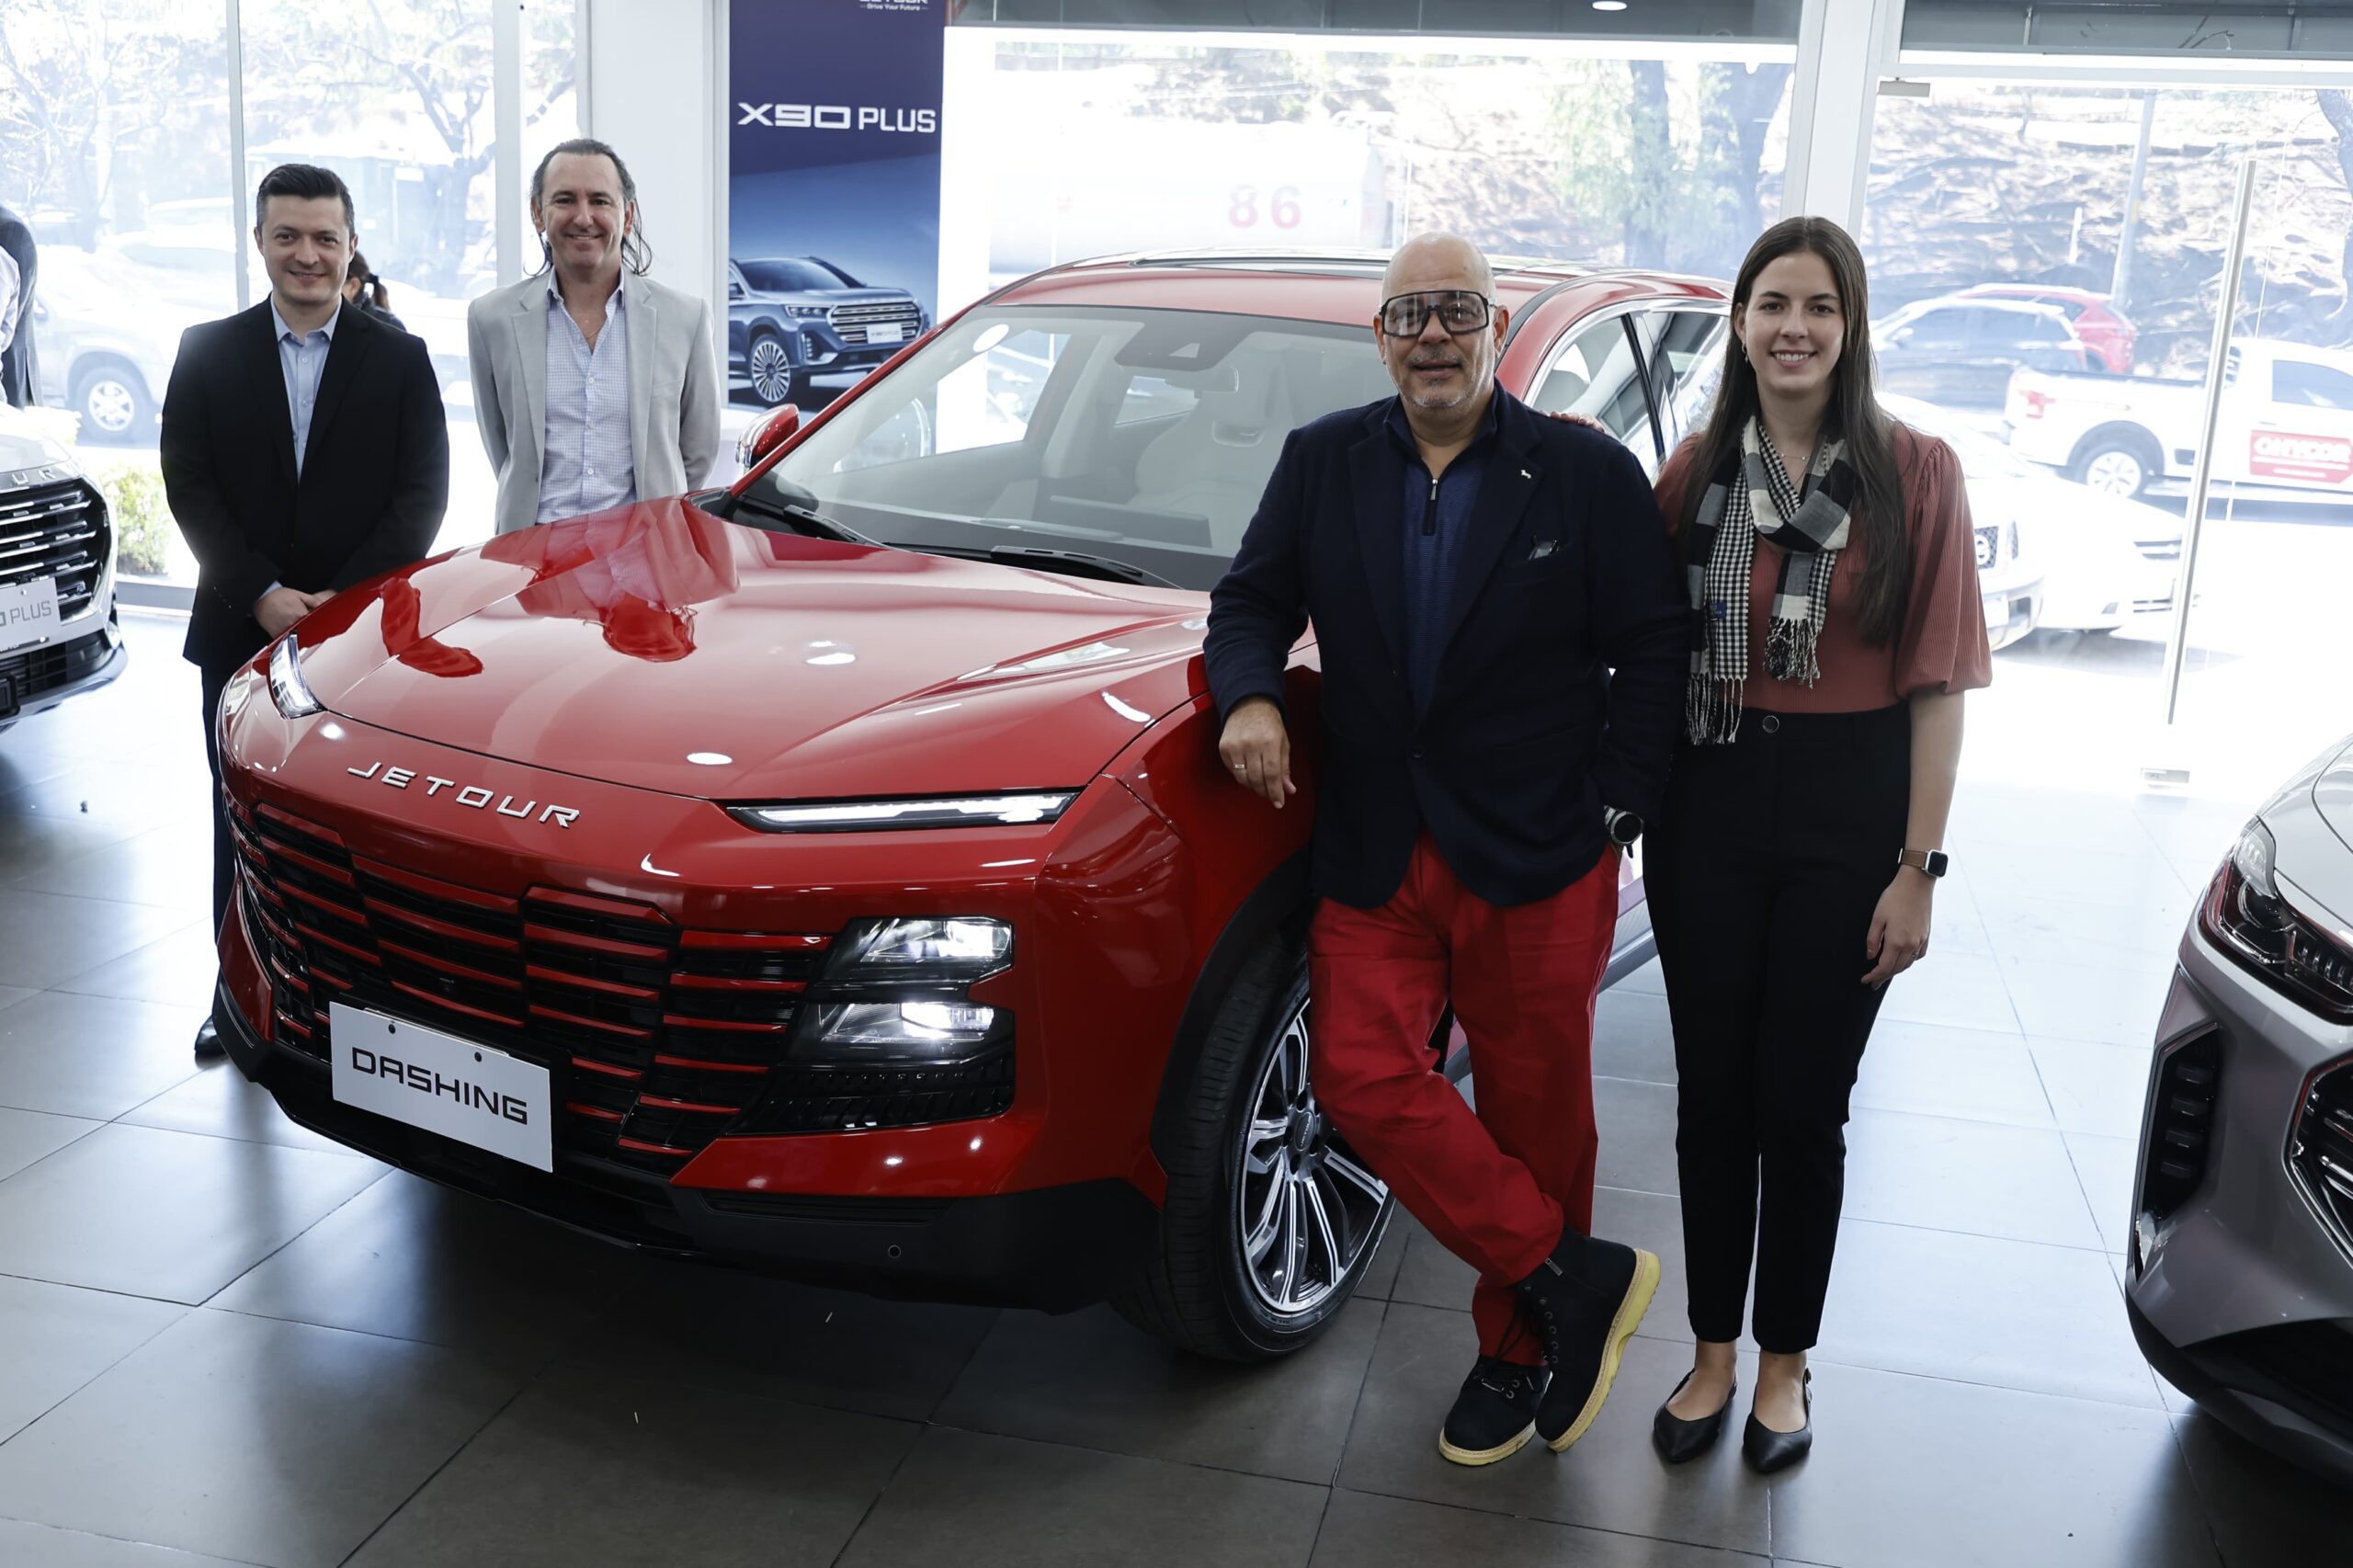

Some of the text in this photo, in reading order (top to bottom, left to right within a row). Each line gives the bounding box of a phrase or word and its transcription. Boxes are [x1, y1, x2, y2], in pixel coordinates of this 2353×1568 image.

[737, 102, 936, 133] X90 PLUS
[10, 600, 51, 625] PLUS
[347, 762, 581, 828] JETOUR
[352, 1046, 528, 1125] DASHING
